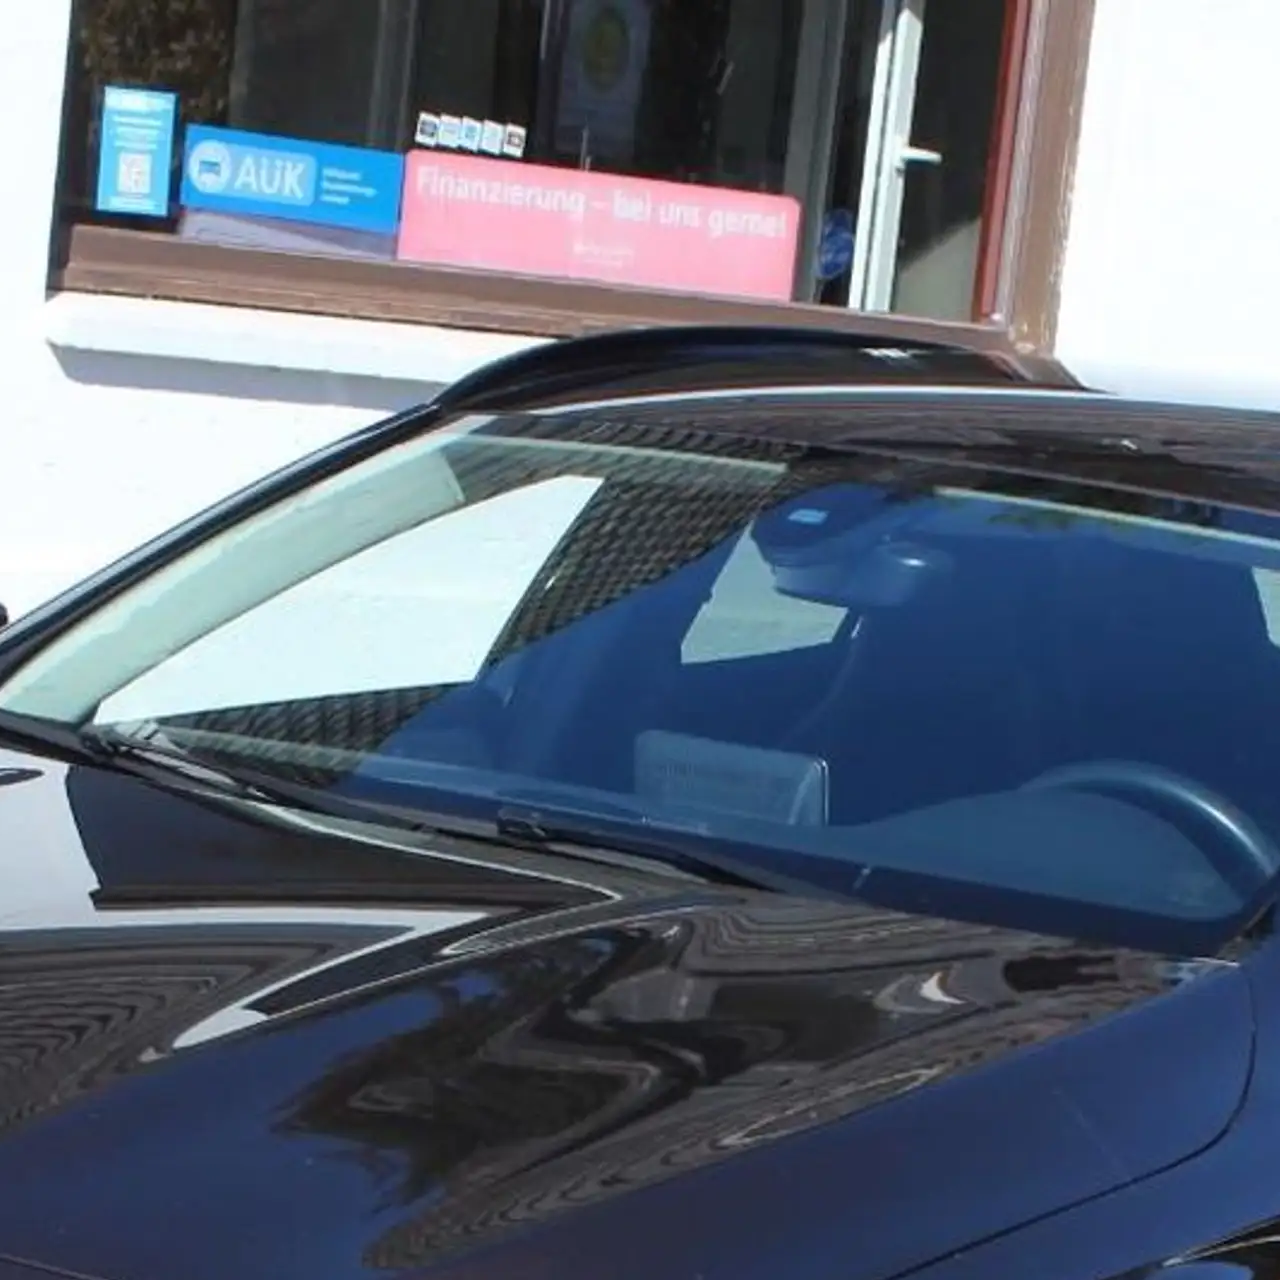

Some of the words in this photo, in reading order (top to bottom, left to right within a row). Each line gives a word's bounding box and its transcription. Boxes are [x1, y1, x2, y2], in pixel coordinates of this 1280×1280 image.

[416, 164, 584, 222] Finanzierung
[613, 187, 651, 222] bei
[659, 203, 700, 228] uns
